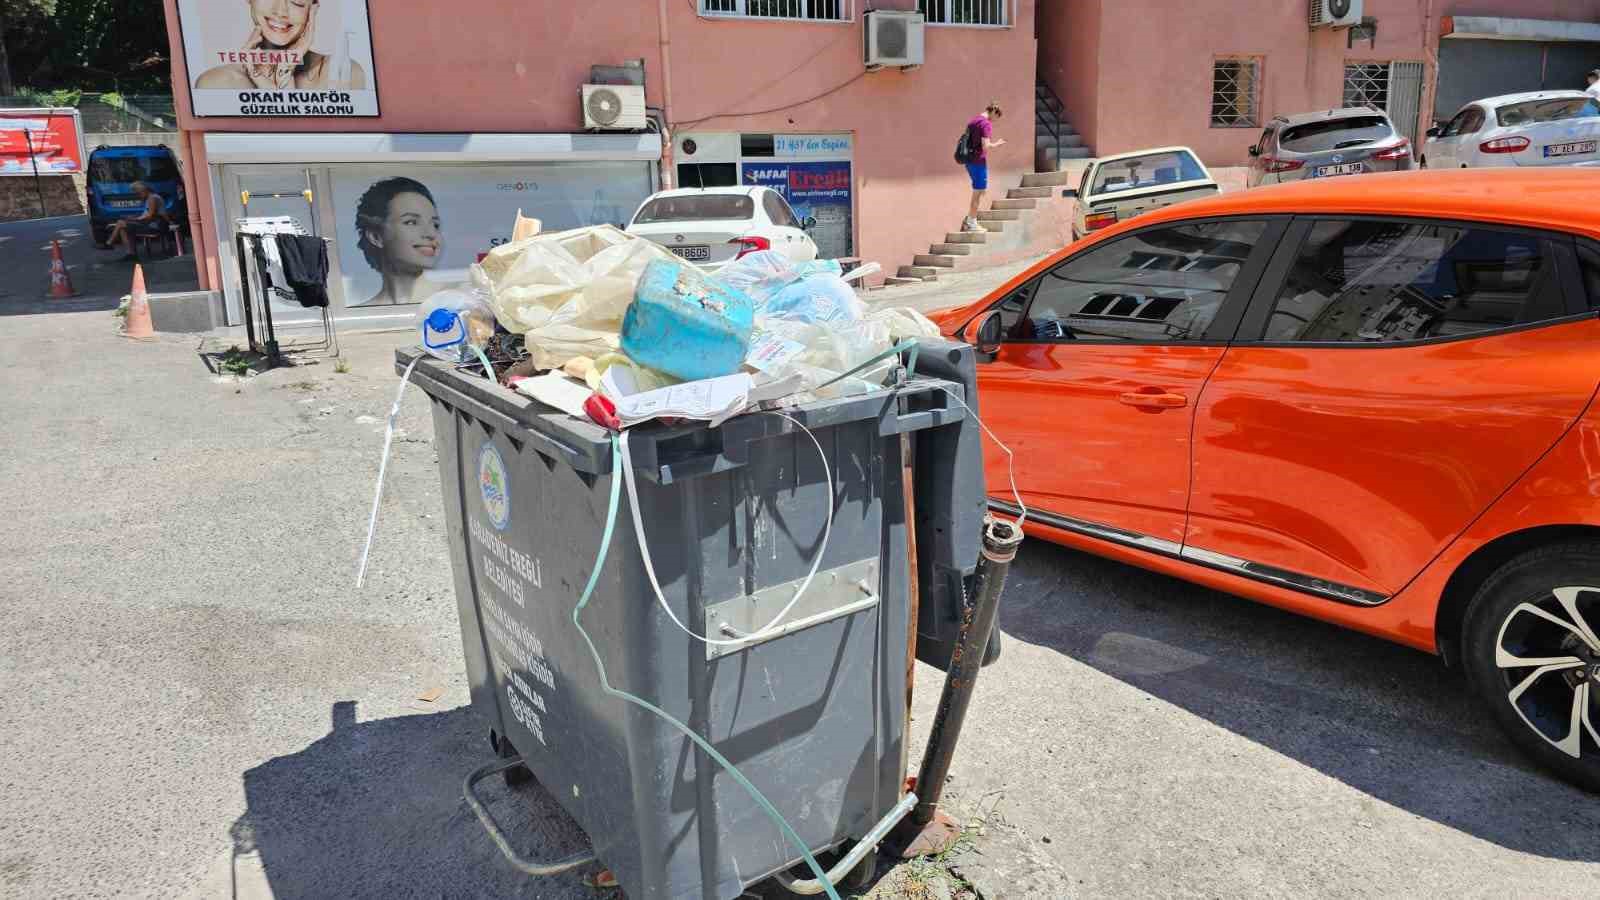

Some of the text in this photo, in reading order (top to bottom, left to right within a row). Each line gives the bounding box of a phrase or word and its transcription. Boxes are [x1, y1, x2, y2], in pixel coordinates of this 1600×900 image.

[238, 90, 351, 103] OKAN KUAFÖR
[304, 105, 354, 115] SALONU
[509, 546, 542, 589] EREĞLİ
[482, 555, 525, 609] BELEDİYESİ
